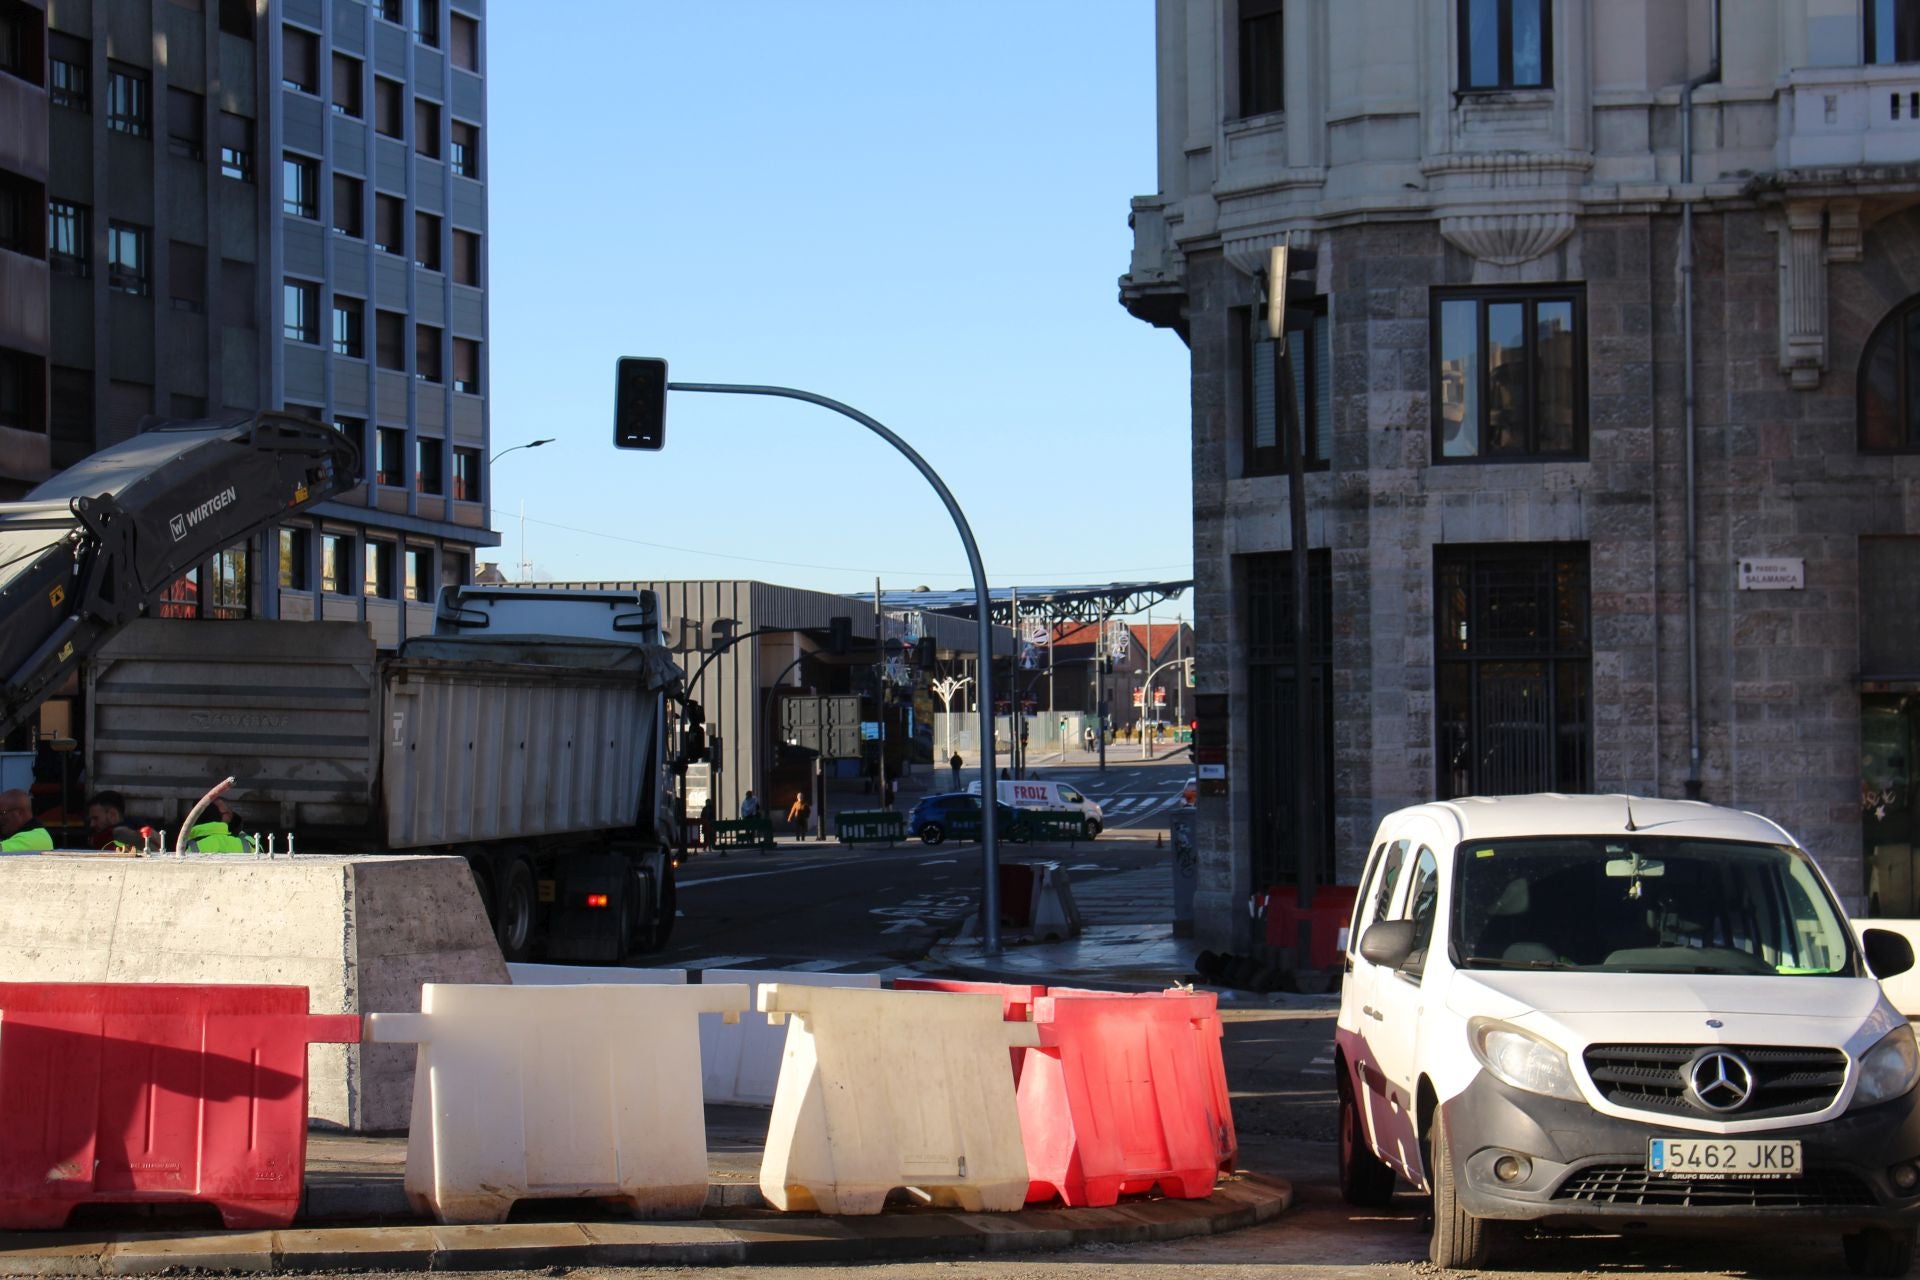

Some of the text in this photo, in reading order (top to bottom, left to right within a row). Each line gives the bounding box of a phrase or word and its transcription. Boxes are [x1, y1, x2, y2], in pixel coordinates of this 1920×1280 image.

[186, 486, 236, 527] WIRTGEN
[1745, 575, 1797, 583] SALAMANCA
[1013, 785, 1048, 800] FROIZ
[1669, 1144, 1736, 1168] 5462
[1748, 1144, 1795, 1169] JKB
